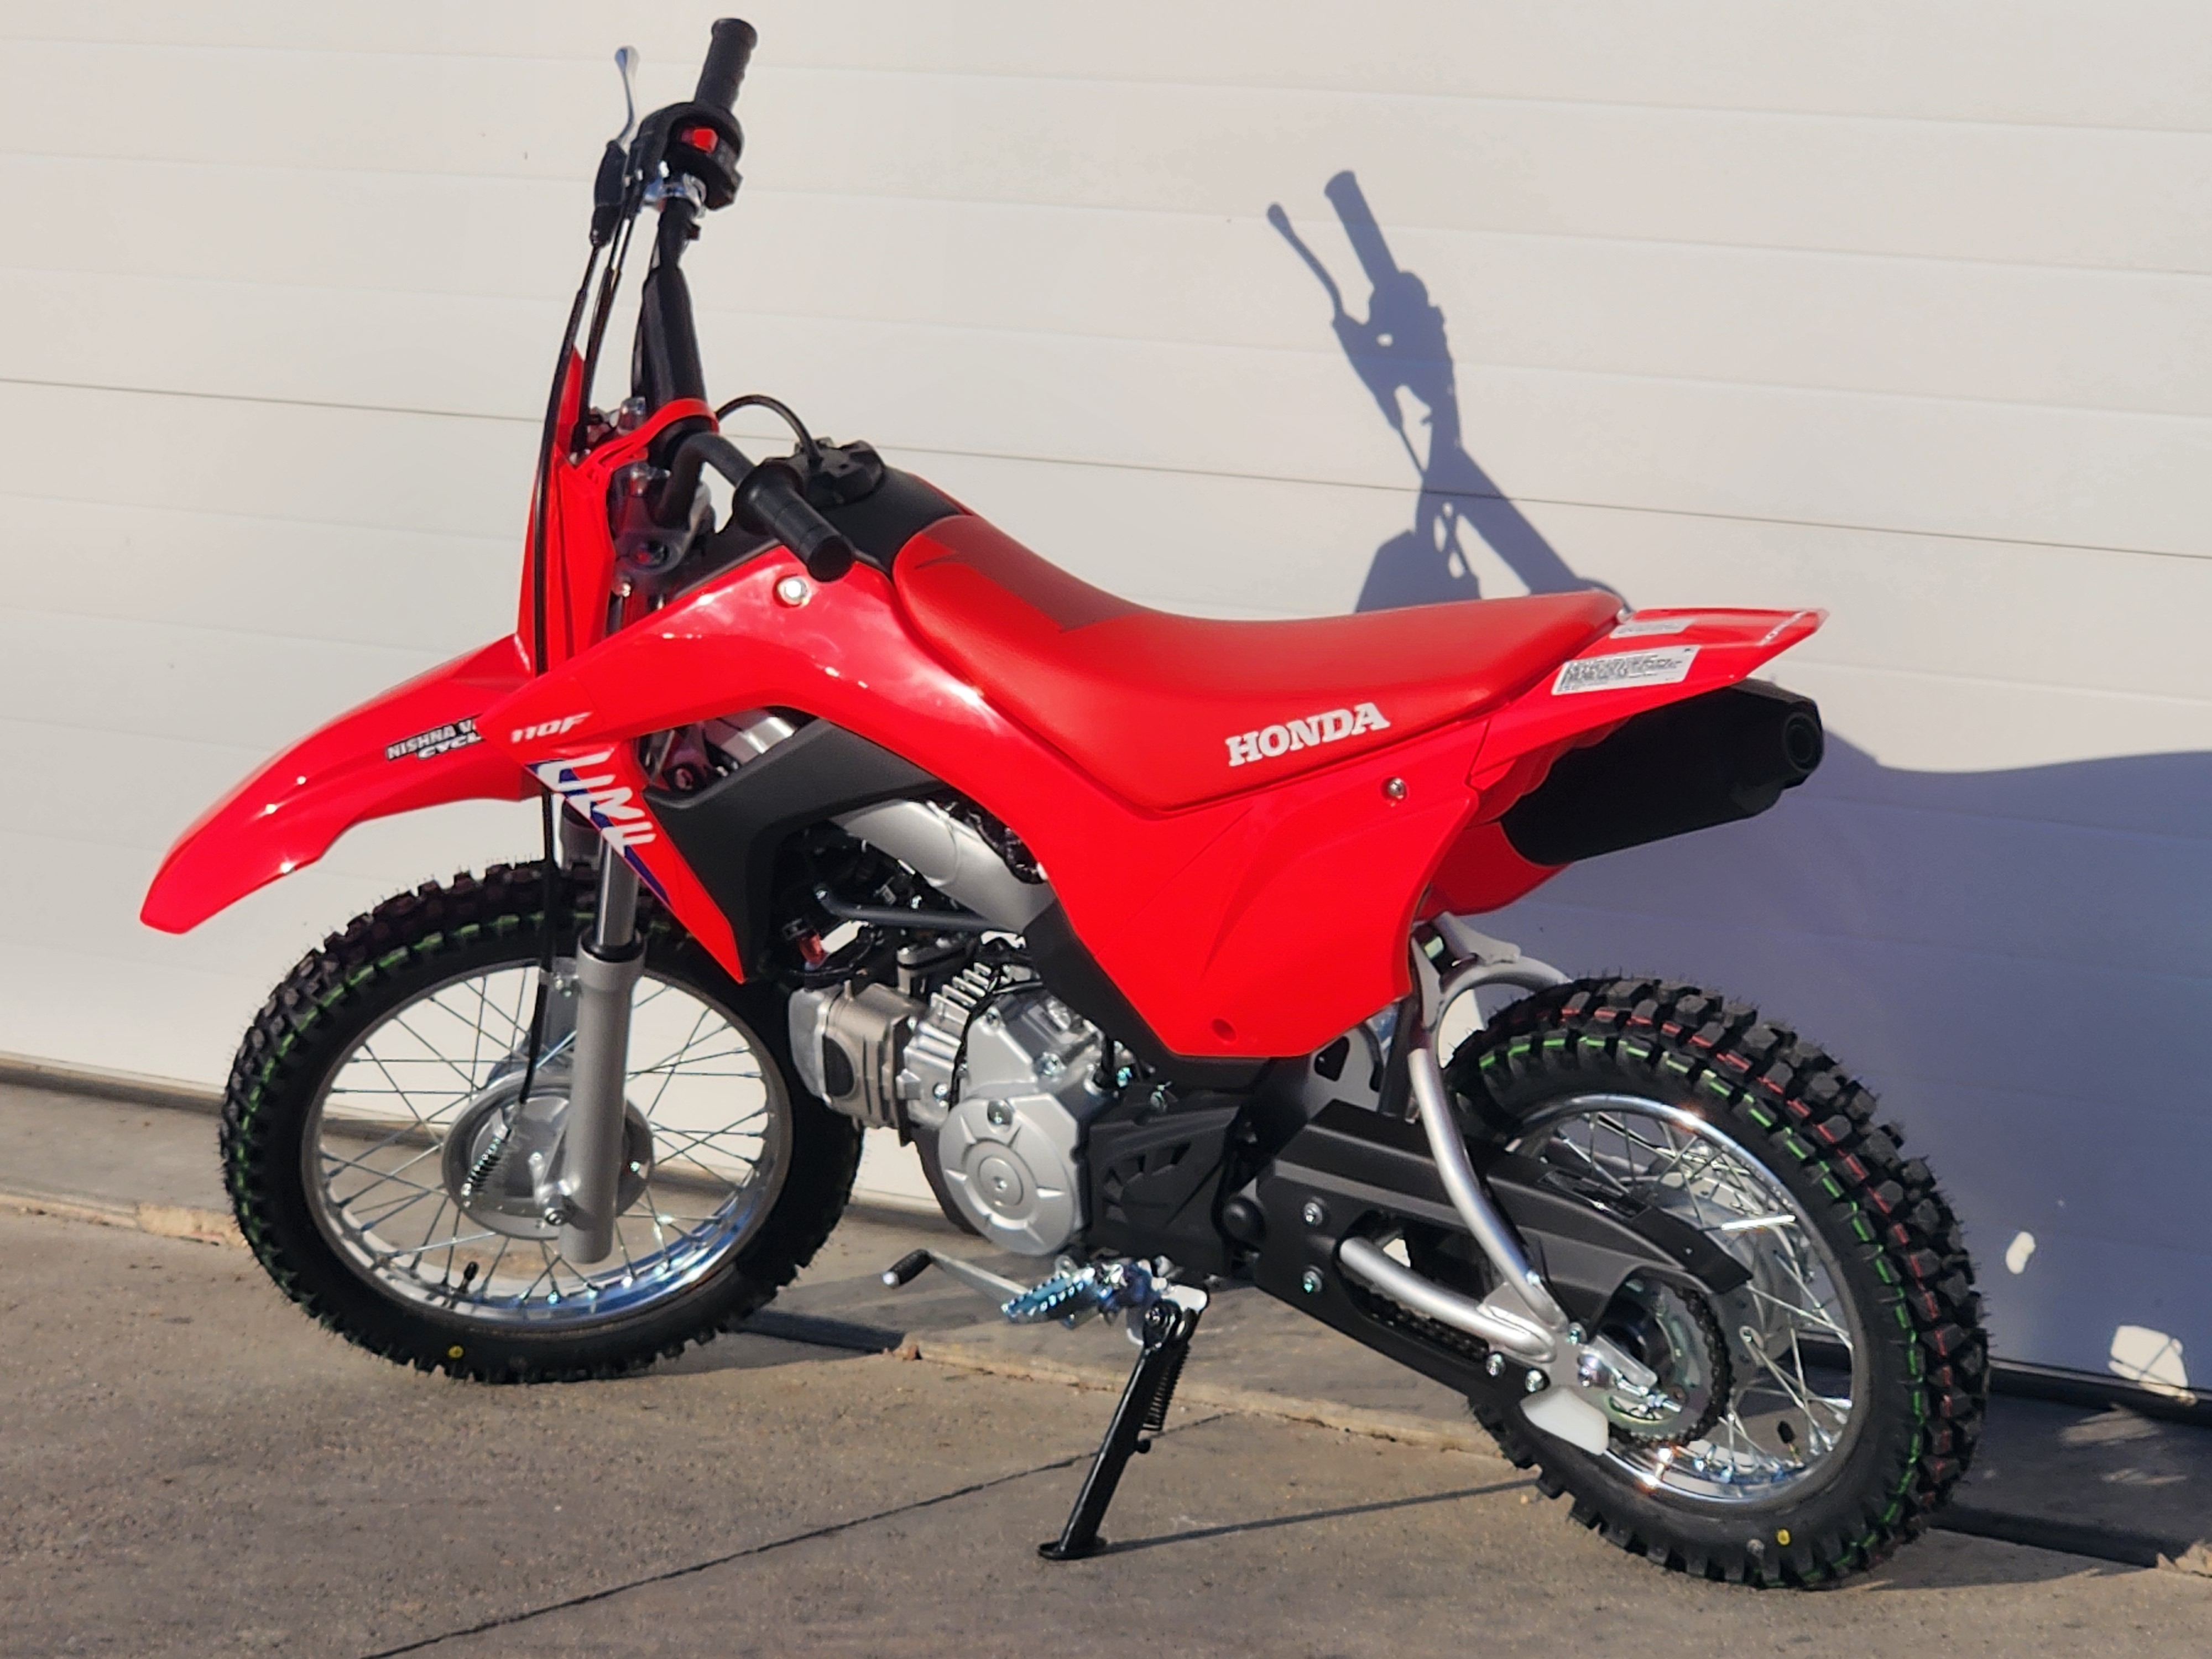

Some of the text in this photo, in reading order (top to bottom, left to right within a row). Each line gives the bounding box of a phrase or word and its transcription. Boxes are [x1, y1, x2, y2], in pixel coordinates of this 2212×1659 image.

[387, 719, 476, 760] NISHNA V
[511, 711, 592, 743] 110F
[1225, 702, 1391, 767] HONDA
